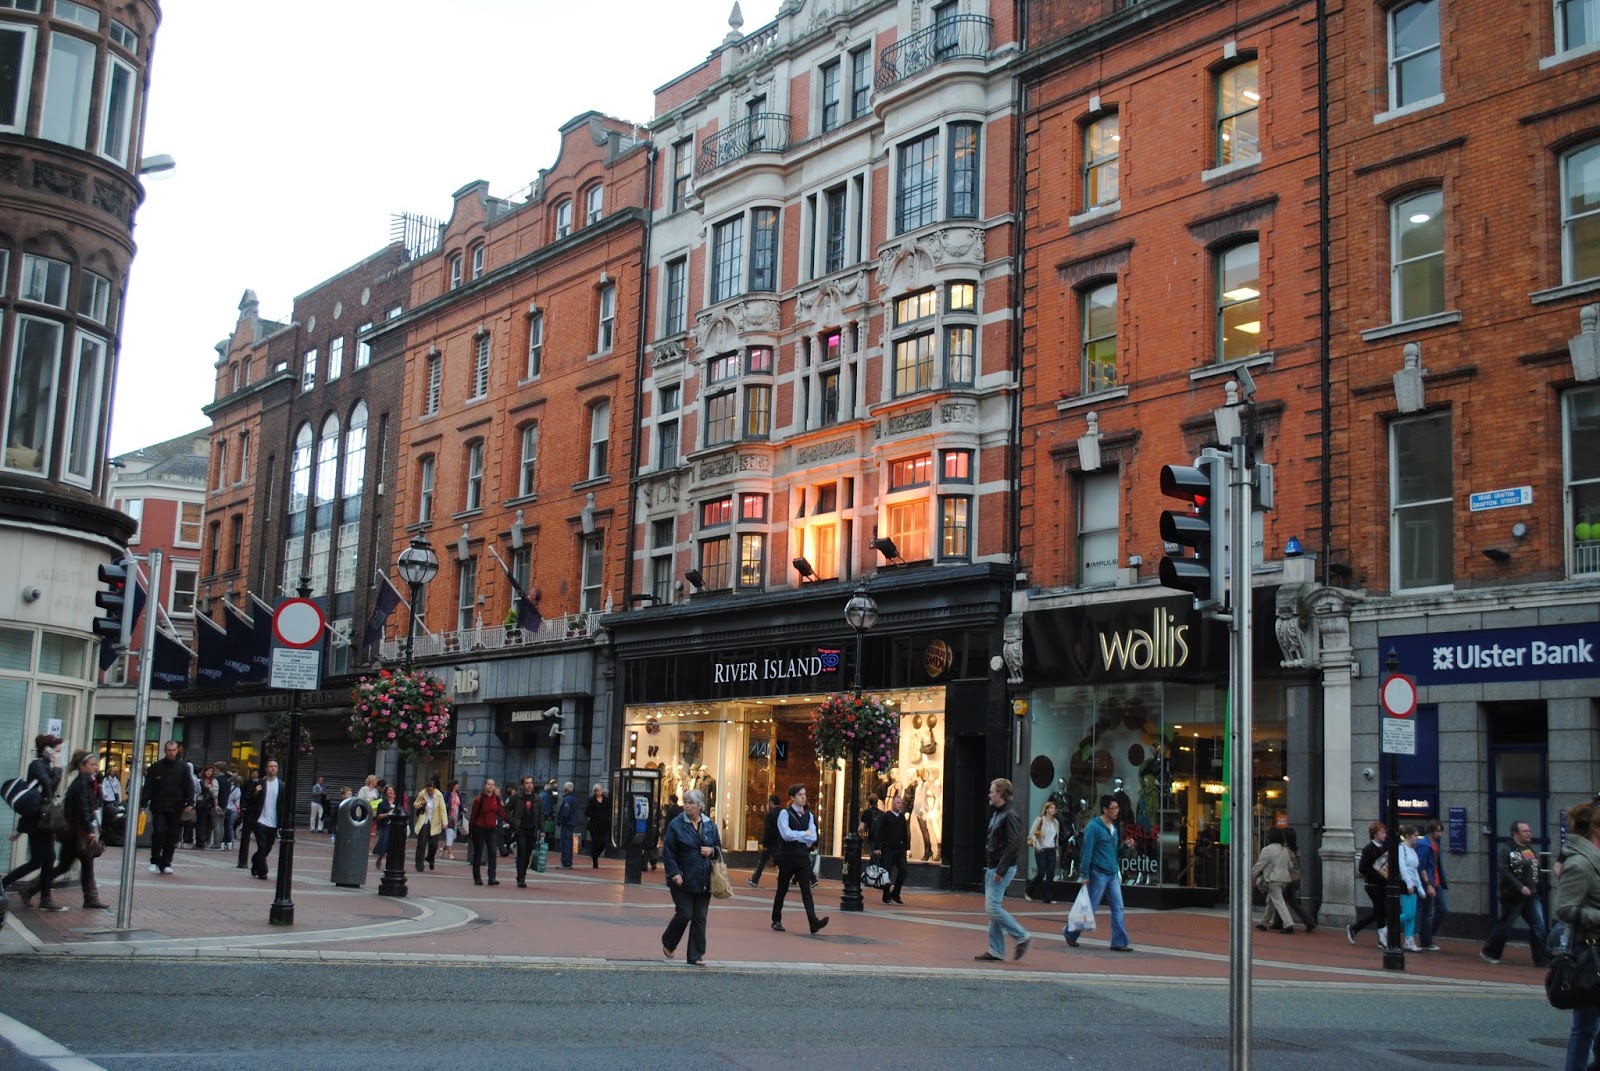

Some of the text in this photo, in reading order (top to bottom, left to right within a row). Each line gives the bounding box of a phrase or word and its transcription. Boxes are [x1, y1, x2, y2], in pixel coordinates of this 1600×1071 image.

[1472, 497, 1520, 509] GRAFTON STREET
[1524, 491, 1529, 500] 2
[1090, 559, 1119, 567] IMPULS
[1099, 606, 1189, 671] wallis
[1456, 638, 1594, 669] Ulster Bank
[714, 662, 758, 683] RIVER
[763, 656, 822, 680] ISLAND
[453, 669, 479, 693] AIB
[462, 746, 477, 757] Bank
[1412, 799, 1429, 808] Bank
[1125, 823, 1160, 840] SALE
[1121, 855, 1158, 875] petite
